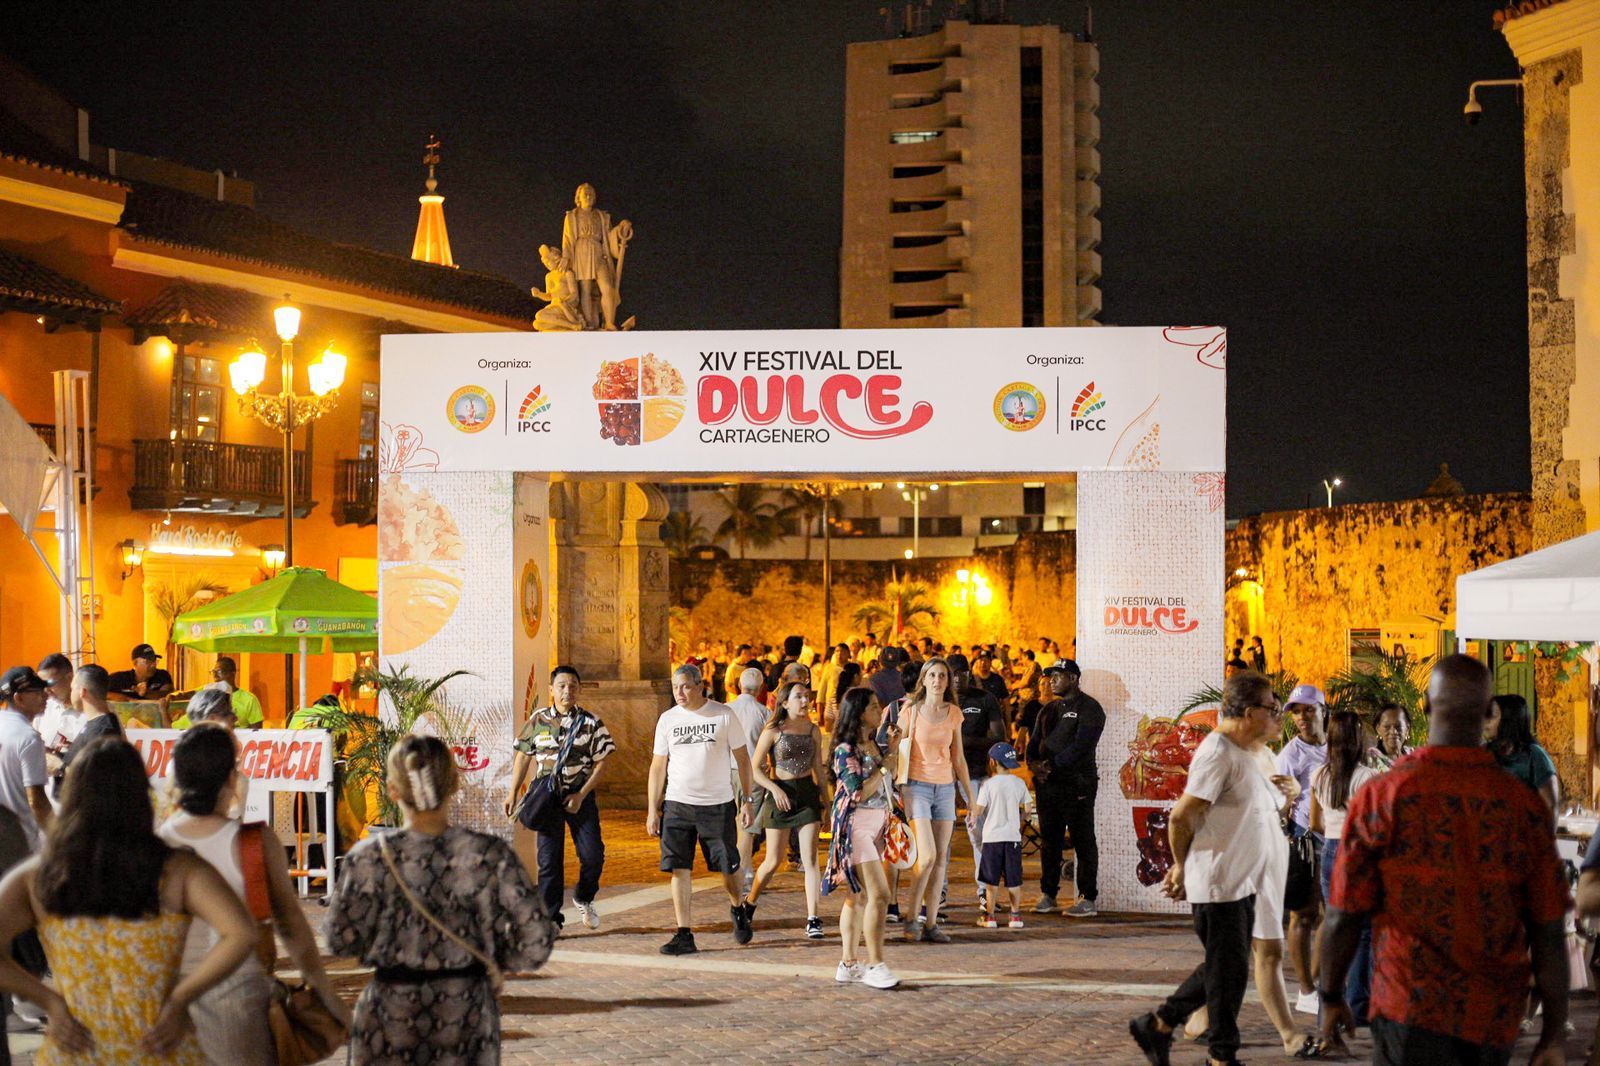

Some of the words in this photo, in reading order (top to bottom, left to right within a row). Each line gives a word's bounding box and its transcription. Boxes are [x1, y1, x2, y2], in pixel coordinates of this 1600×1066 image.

[478, 358, 532, 371] Organiza:
[699, 351, 738, 371] XIV
[744, 350, 850, 371] FESTIVAL
[857, 350, 902, 370] DEL
[1026, 354, 1084, 367] Organiza:
[697, 373, 934, 440] DULCE
[518, 421, 551, 432] IPCC
[1071, 419, 1106, 431] IPCC
[699, 428, 830, 444] CARTAGENERO
[151, 522, 184, 545] Hard
[184, 525, 214, 547] Rock
[1104, 596, 1120, 605] XIV
[1122, 596, 1166, 606] FESTIVAL
[1167, 597, 1186, 606] DEL
[1104, 606, 1199, 634] DULCE
[1104, 628, 1158, 636] CARTAGENERO
[673, 723, 717, 738] SUMMIT
[237, 740, 323, 782] GENCIA
